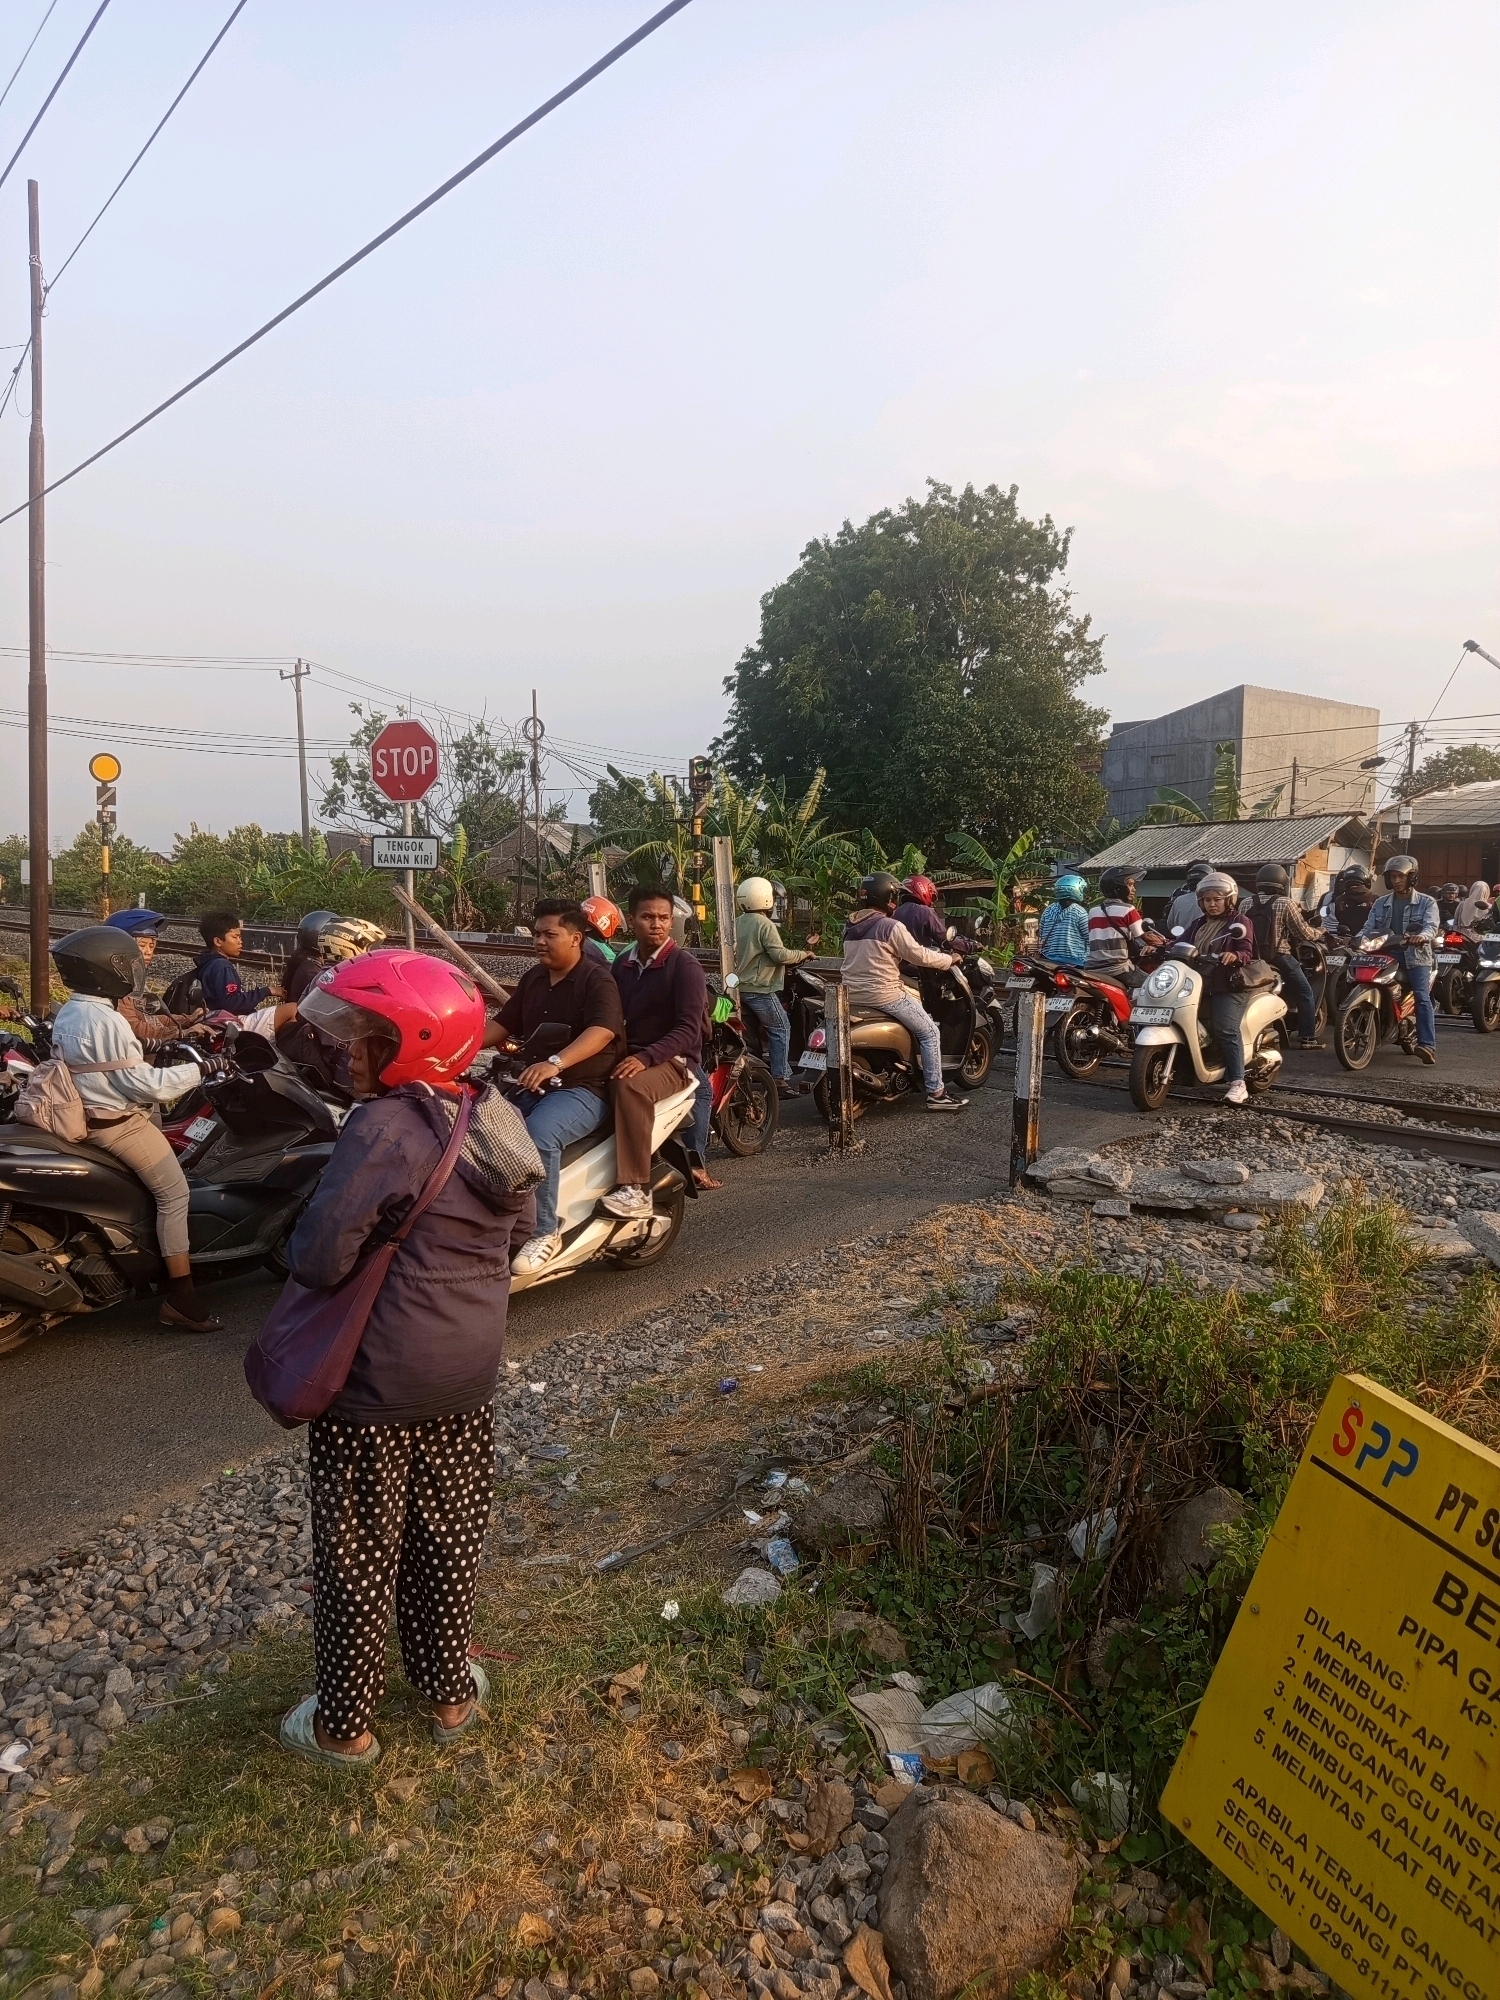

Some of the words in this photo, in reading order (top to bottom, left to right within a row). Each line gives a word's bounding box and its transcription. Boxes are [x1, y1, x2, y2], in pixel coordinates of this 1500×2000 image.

[376, 746, 434, 778] STOP
[377, 852, 410, 865] KANAN
[414, 852, 433, 865] KIRI
[386, 840, 424, 852] TENGOK
[1332, 1405, 1419, 1488] SPP
[1434, 1483, 1479, 1533] PT
[1303, 1606, 1410, 1693] DILARANG:
[1397, 1615, 1459, 1678] PIPA
[1432, 1570, 1500, 1650] BE
[1283, 1656, 1297, 1678] 2.
[1302, 1670, 1427, 1778] MENDIRIKAN
[1296, 1633, 1307, 1654] 1.
[1312, 1646, 1412, 1729] MEMBUAT
[1411, 1725, 1450, 1761] API
[1459, 1697, 1498, 1738] KP:
[1263, 1706, 1276, 1726] 4.
[1282, 1719, 1378, 1805] MEMBUAT
[1380, 1802, 1461, 1878] GALIAN
[1273, 1680, 1286, 1702] 3.
[1292, 1694, 1440, 1823] MENGGANGGU
[1232, 1776, 1309, 1853] APABILA
[1314, 1844, 1398, 1930] TERJADI
[1253, 1727, 1266, 1750] 5.
[1271, 1743, 1366, 1831] MELINTAS
[1366, 1827, 1424, 1878] ALAT
[1424, 1873, 1500, 1944] BERAT
[1223, 1798, 1295, 1875] SEGERA
[1299, 1867, 1390, 1960] HUBUNGI
[1393, 1953, 1423, 1986] PT
[1309, 1912, 1410, 2000] 0296-8111
